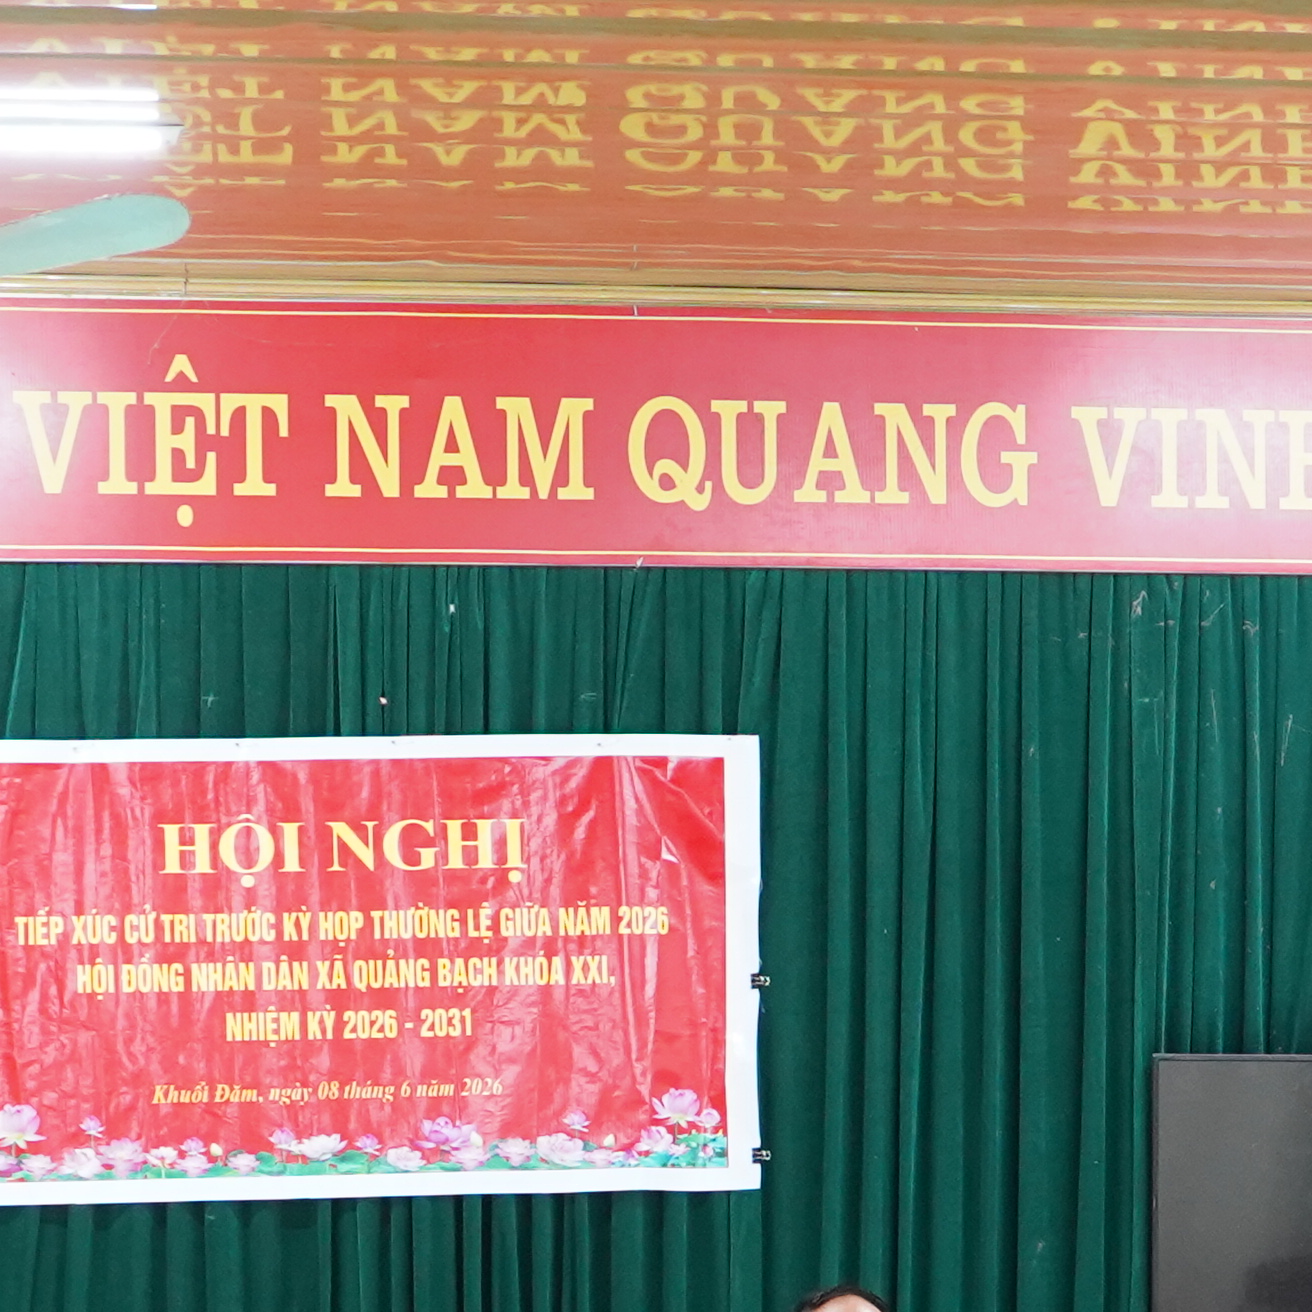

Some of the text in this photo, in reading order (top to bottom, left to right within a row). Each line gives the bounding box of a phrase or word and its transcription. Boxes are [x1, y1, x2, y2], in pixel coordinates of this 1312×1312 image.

[13, 353, 289, 528] VIỆT
[325, 394, 595, 501] NAM
[627, 395, 1038, 511] QUANG
[157, 813, 528, 888] HỘI NGHỊ
[14, 900, 669, 947] TIẾP XÚC CỬ TRI TRƯỚC KỲ HỌP THƯỜNG LỆ GIỮA NĂM 2026
[76, 949, 616, 1000] HỘI ĐỒNG NHÂN DÂN XÃ QUẢNG BẠCH KHÓA XXI,
[225, 1005, 300, 1048] NHIỆM
[307, 1004, 336, 1040] KỲ
[343, 1010, 397, 1039] 2026
[420, 1008, 472, 1038] 2031
[152, 1077, 503, 1106] Khuổi Đăm, ngày 08 tháng 6 năm 2026
